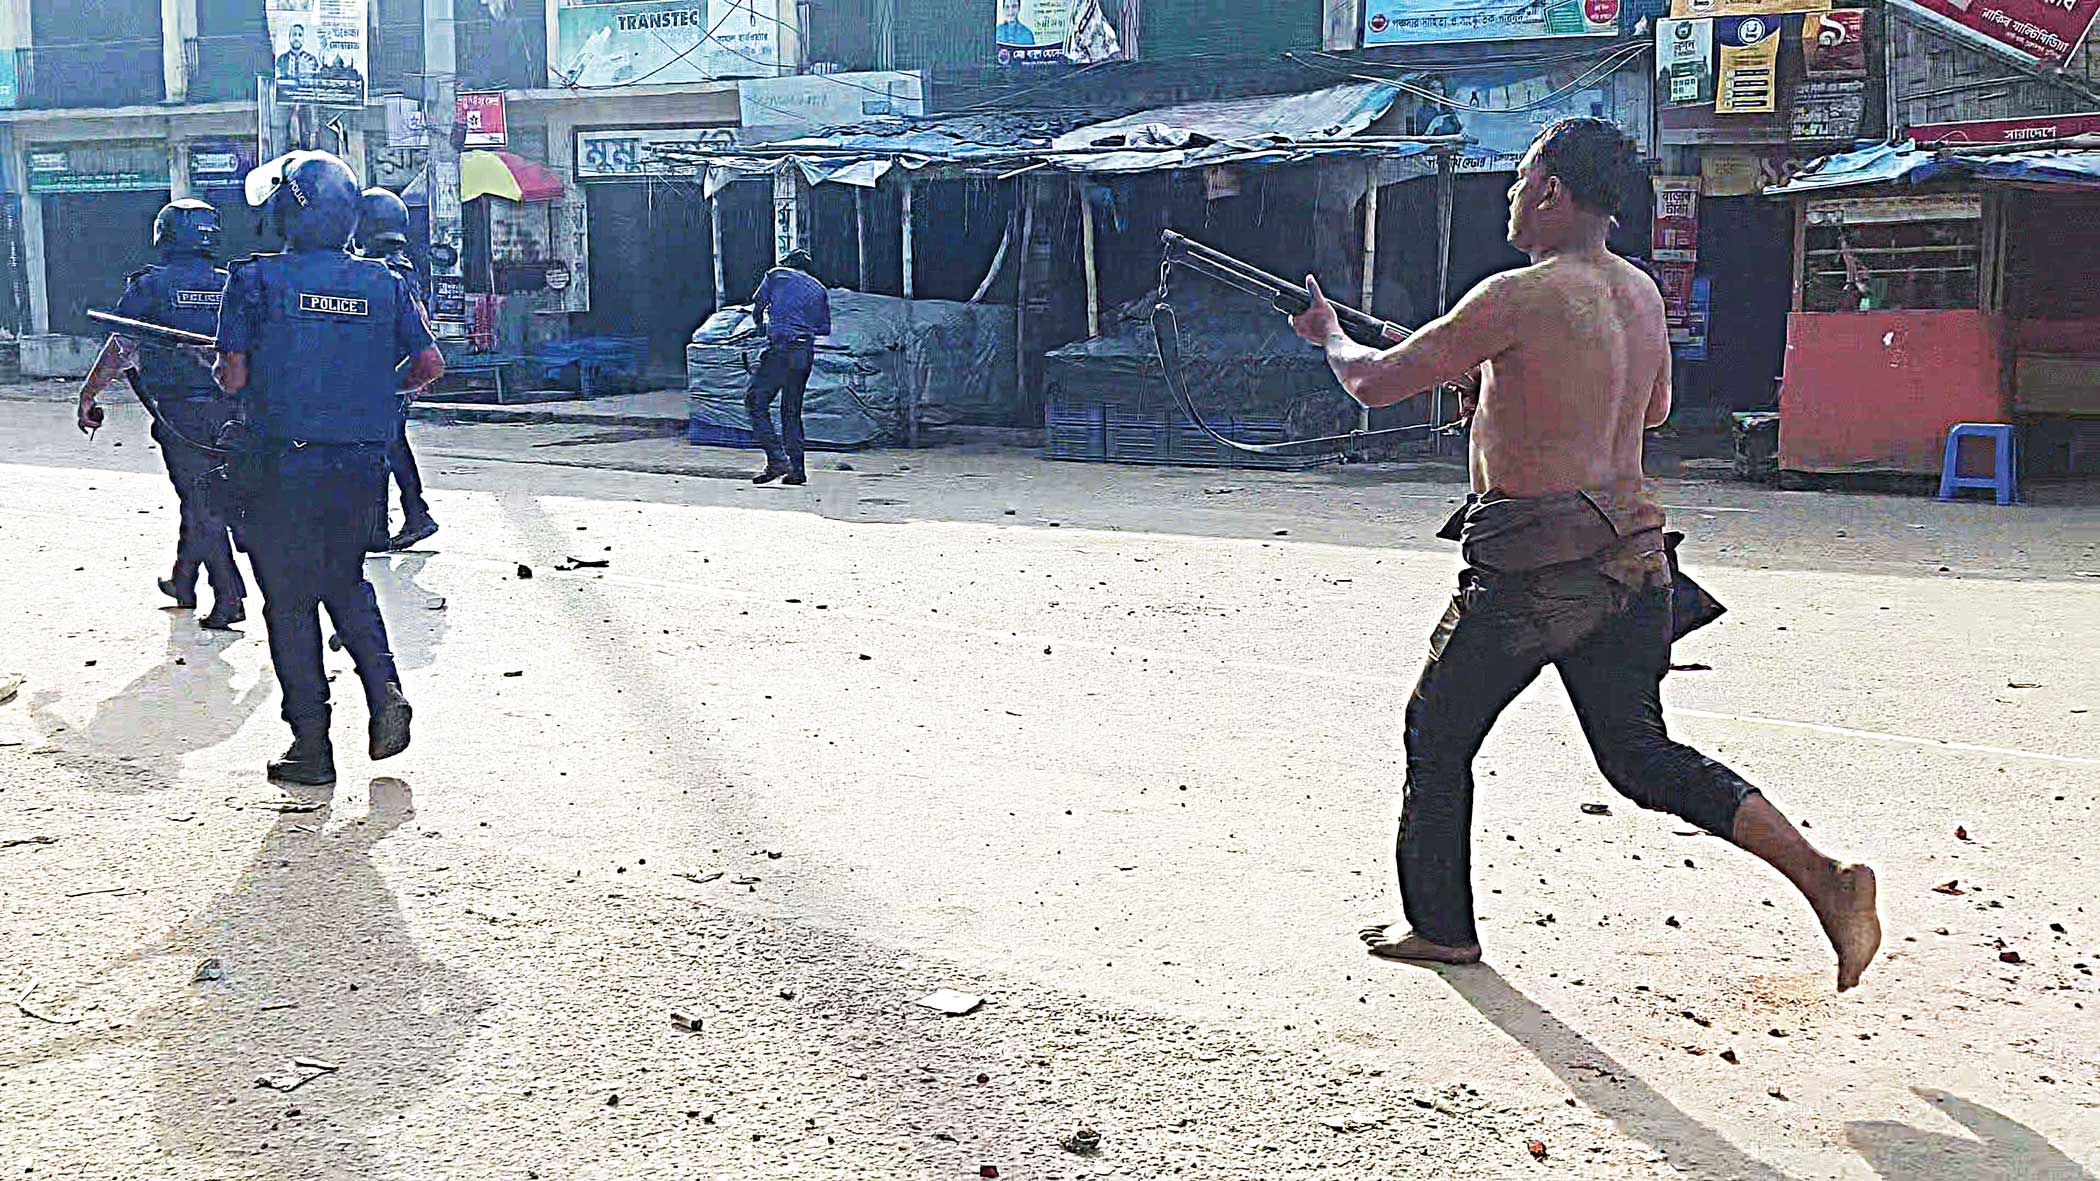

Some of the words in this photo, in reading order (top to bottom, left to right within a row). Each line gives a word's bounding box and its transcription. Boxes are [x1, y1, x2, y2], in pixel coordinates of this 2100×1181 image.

[617, 10, 699, 31] TRANSTEC
[2003, 125, 2057, 140] সারাদেশে
[311, 297, 358, 312] POLICE
